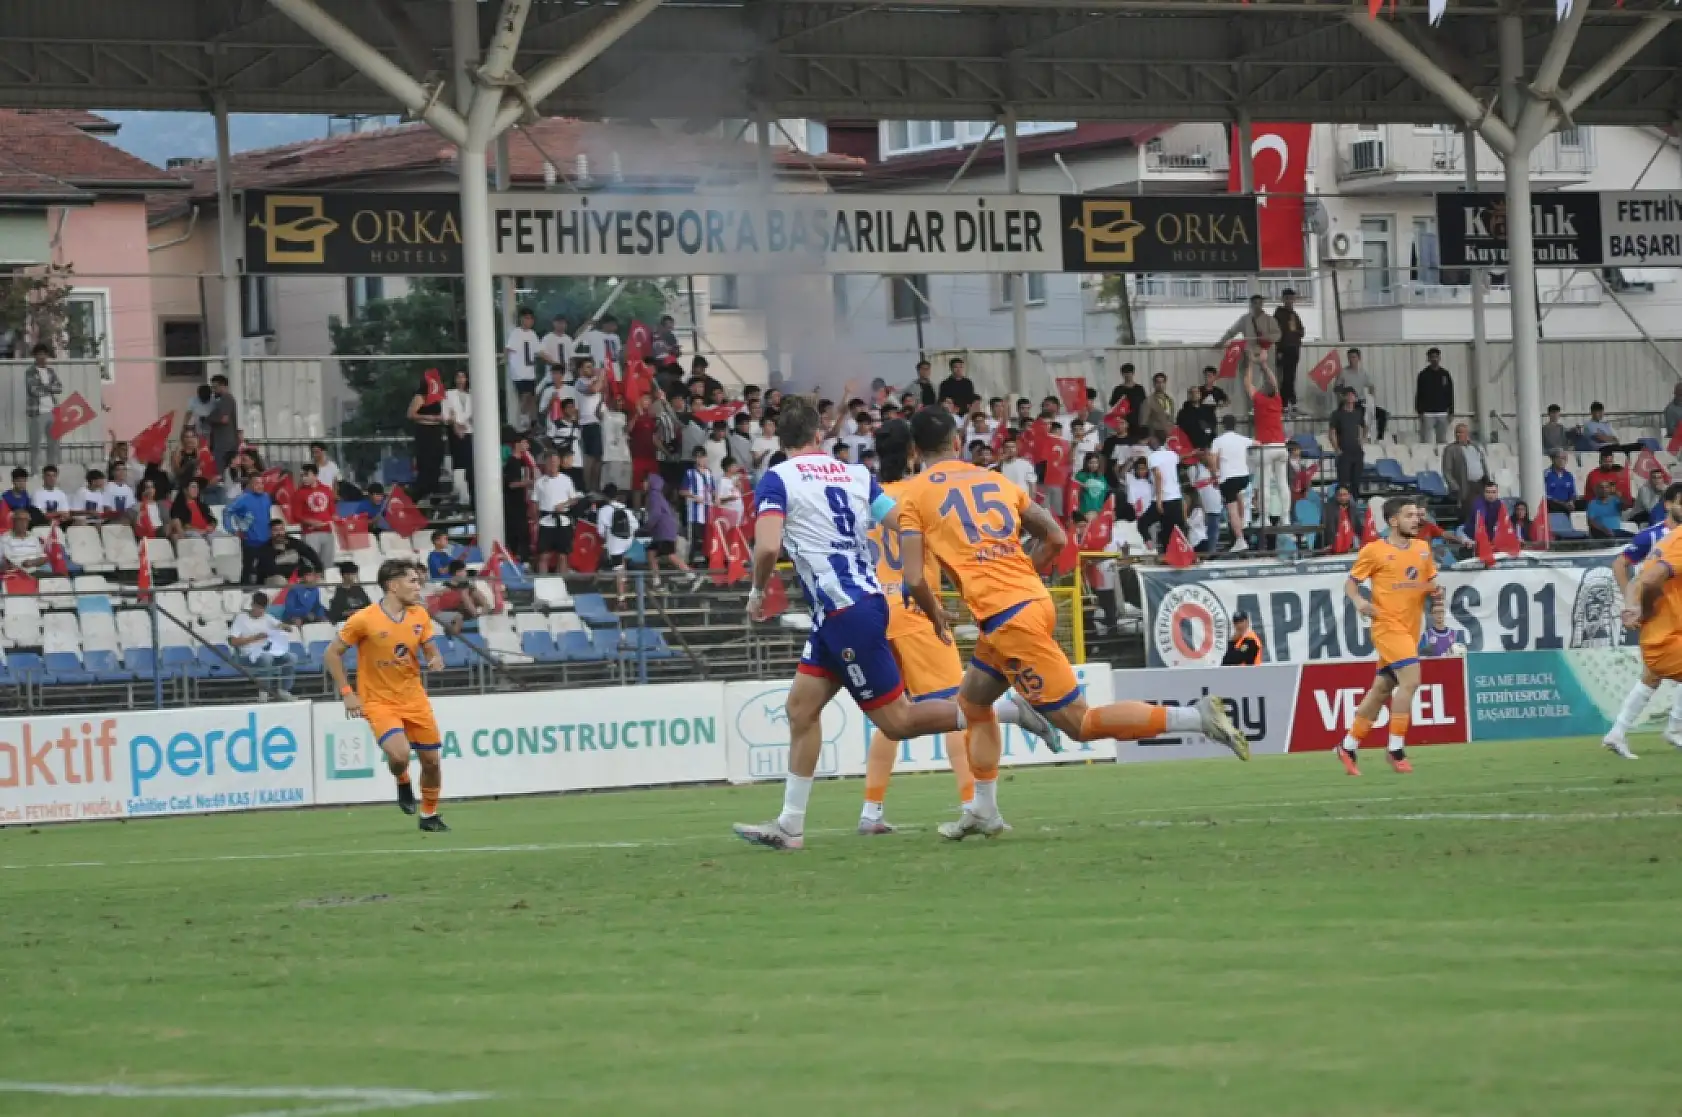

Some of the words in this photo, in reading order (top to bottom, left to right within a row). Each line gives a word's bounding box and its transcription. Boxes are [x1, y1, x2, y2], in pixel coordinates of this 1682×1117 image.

[352, 209, 463, 245] ORKA
[495, 196, 758, 255] FETHİYESPOR'A
[954, 196, 1044, 254] DİLER
[1155, 212, 1250, 245] ORKA
[371, 250, 449, 264] HOTELS
[1173, 250, 1239, 263] HOTELS
[939, 483, 1015, 545] 15
[1498, 583, 1564, 652] 91
[1475, 675, 1496, 688] SEA
[1498, 673, 1514, 686] ME
[129, 711, 298, 798] perde
[471, 716, 717, 758] CONSTRUCTION
